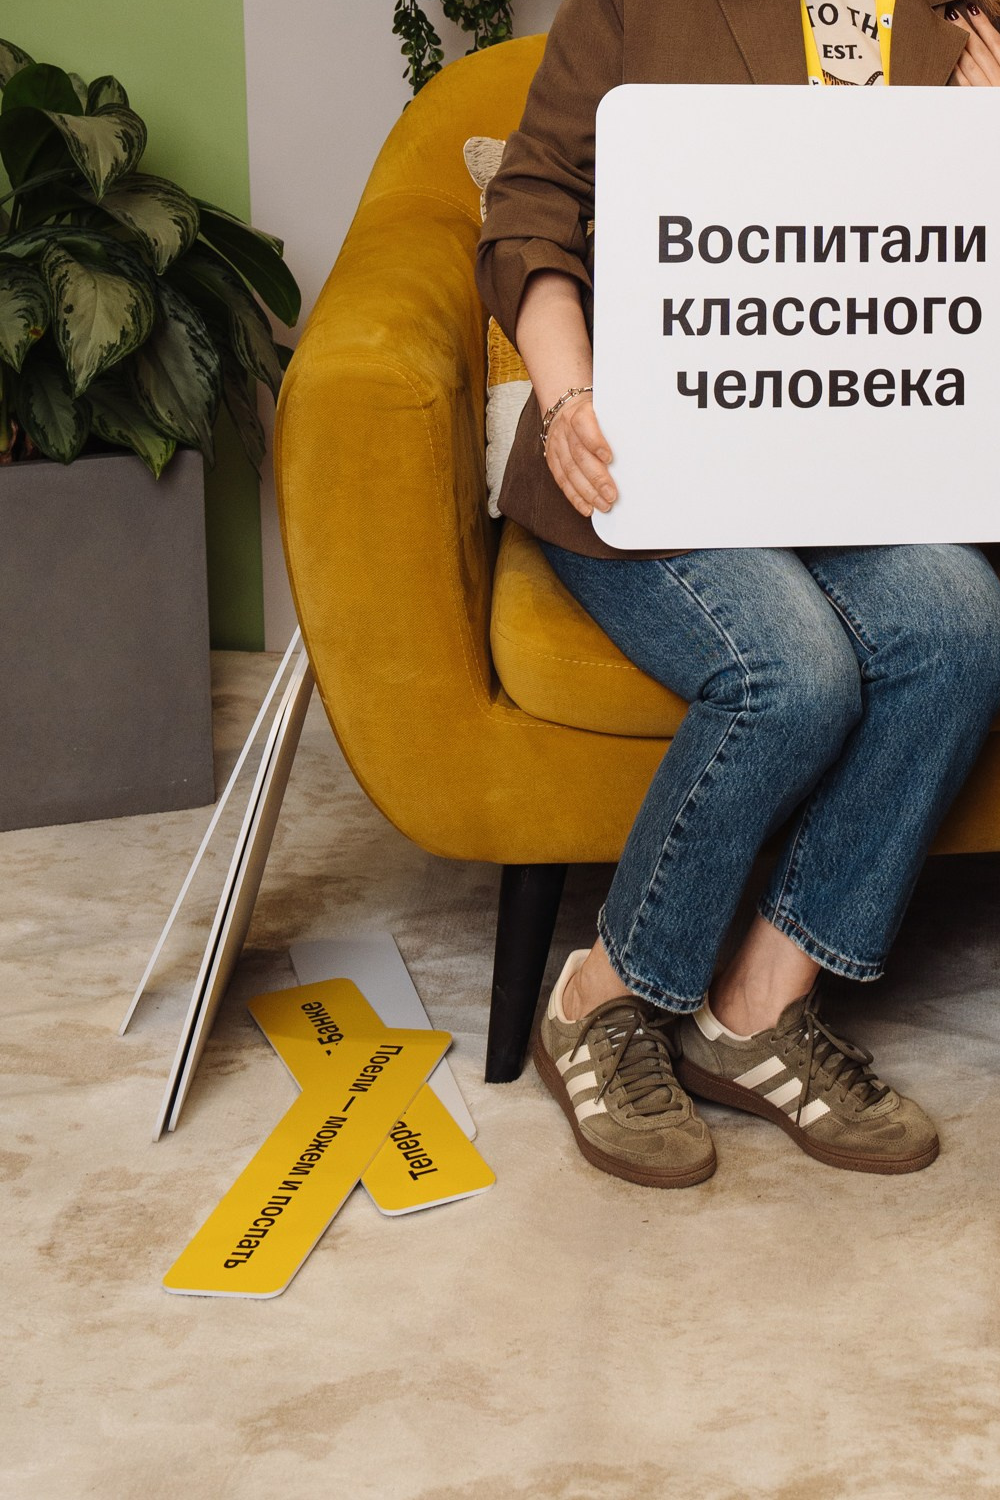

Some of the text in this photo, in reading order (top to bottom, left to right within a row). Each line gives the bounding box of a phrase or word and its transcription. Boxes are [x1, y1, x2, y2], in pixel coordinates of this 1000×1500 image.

[846, 6, 880, 42] TH
[822, 44, 863, 60] EST.
[658, 215, 986, 264] Воспитали
[662, 296, 982, 336] классного
[677, 367, 965, 409] человека
[300, 1001, 345, 1046] Банке
[348, 1044, 404, 1093] Поели
[288, 1115, 348, 1176] можем
[277, 1180, 303, 1191] и
[223, 1195, 292, 1269] поспать
